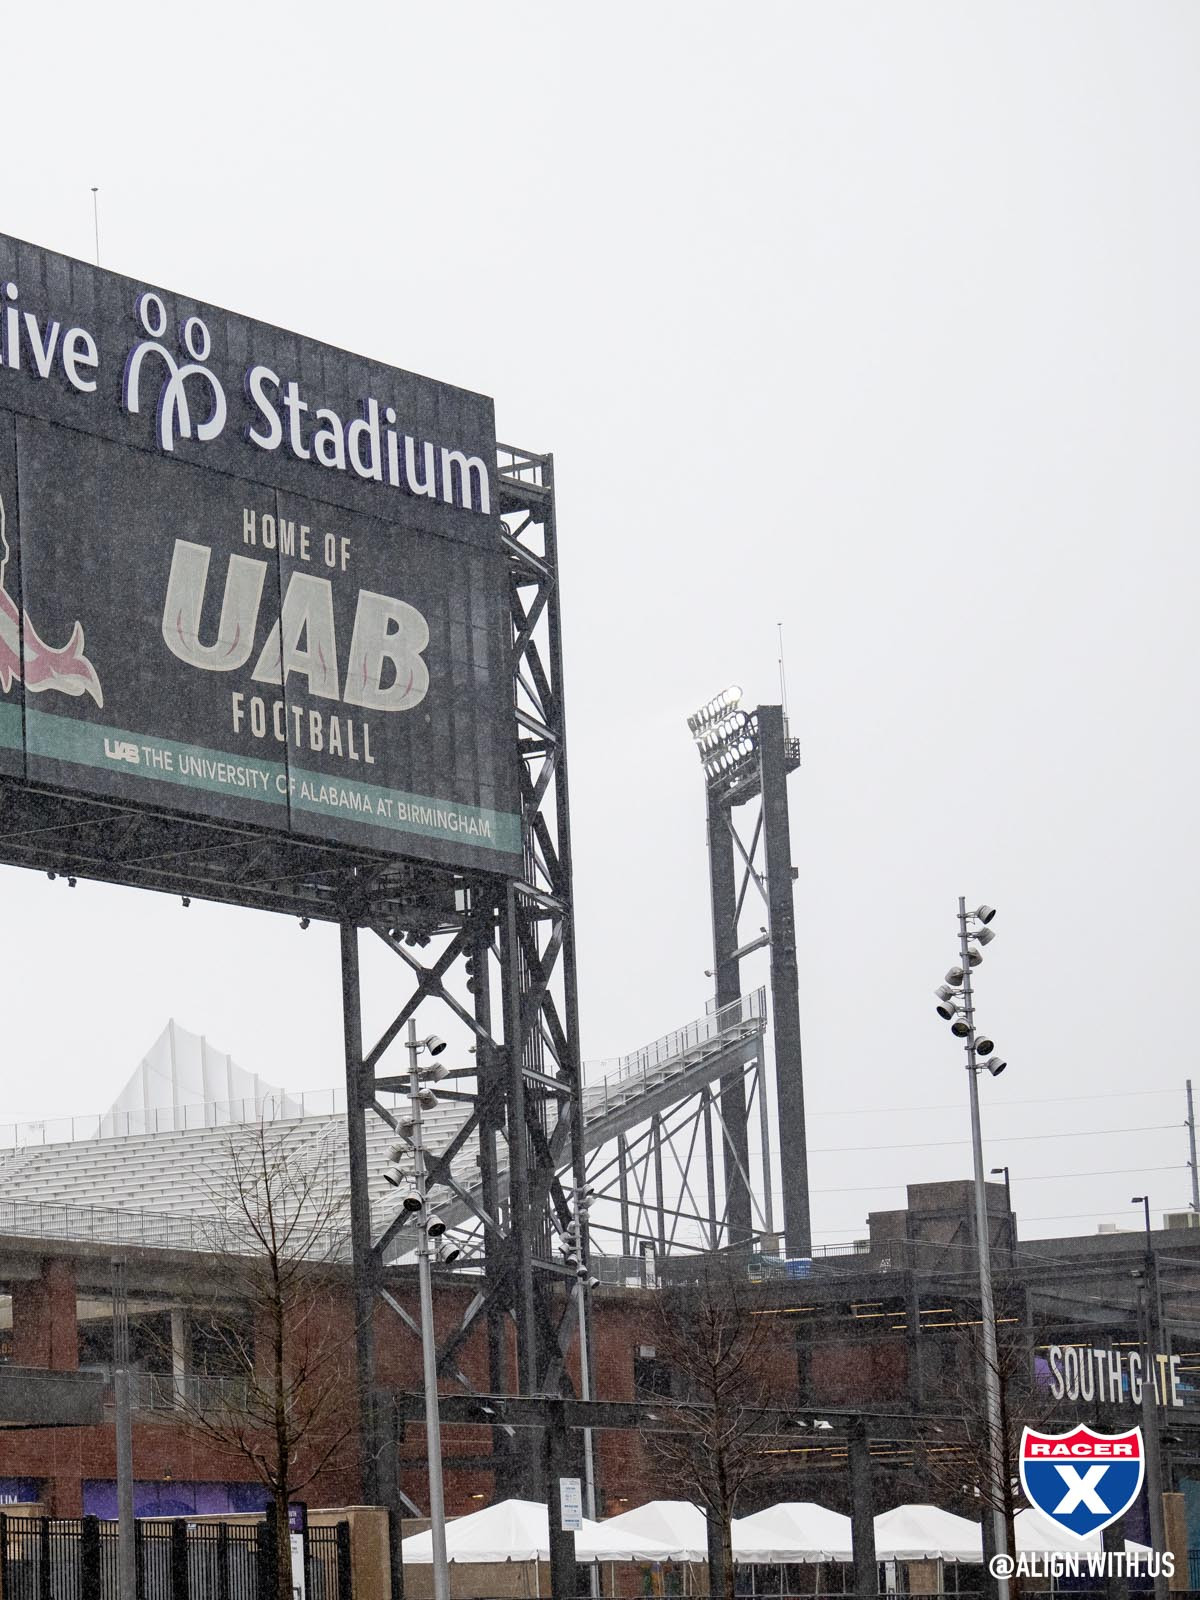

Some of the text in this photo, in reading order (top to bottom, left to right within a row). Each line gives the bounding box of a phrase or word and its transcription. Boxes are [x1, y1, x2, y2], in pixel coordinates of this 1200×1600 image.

[245, 366, 491, 514] Stadium
[243, 508, 351, 571] HOME OF
[162, 538, 430, 712] UAB
[232, 692, 375, 764] FOOTBALL
[104, 738, 491, 838] UAB THE UNIVERSITY OF ALABAMA AT BIRMINGHAM
[1049, 1344, 1123, 1404] SOUTH
